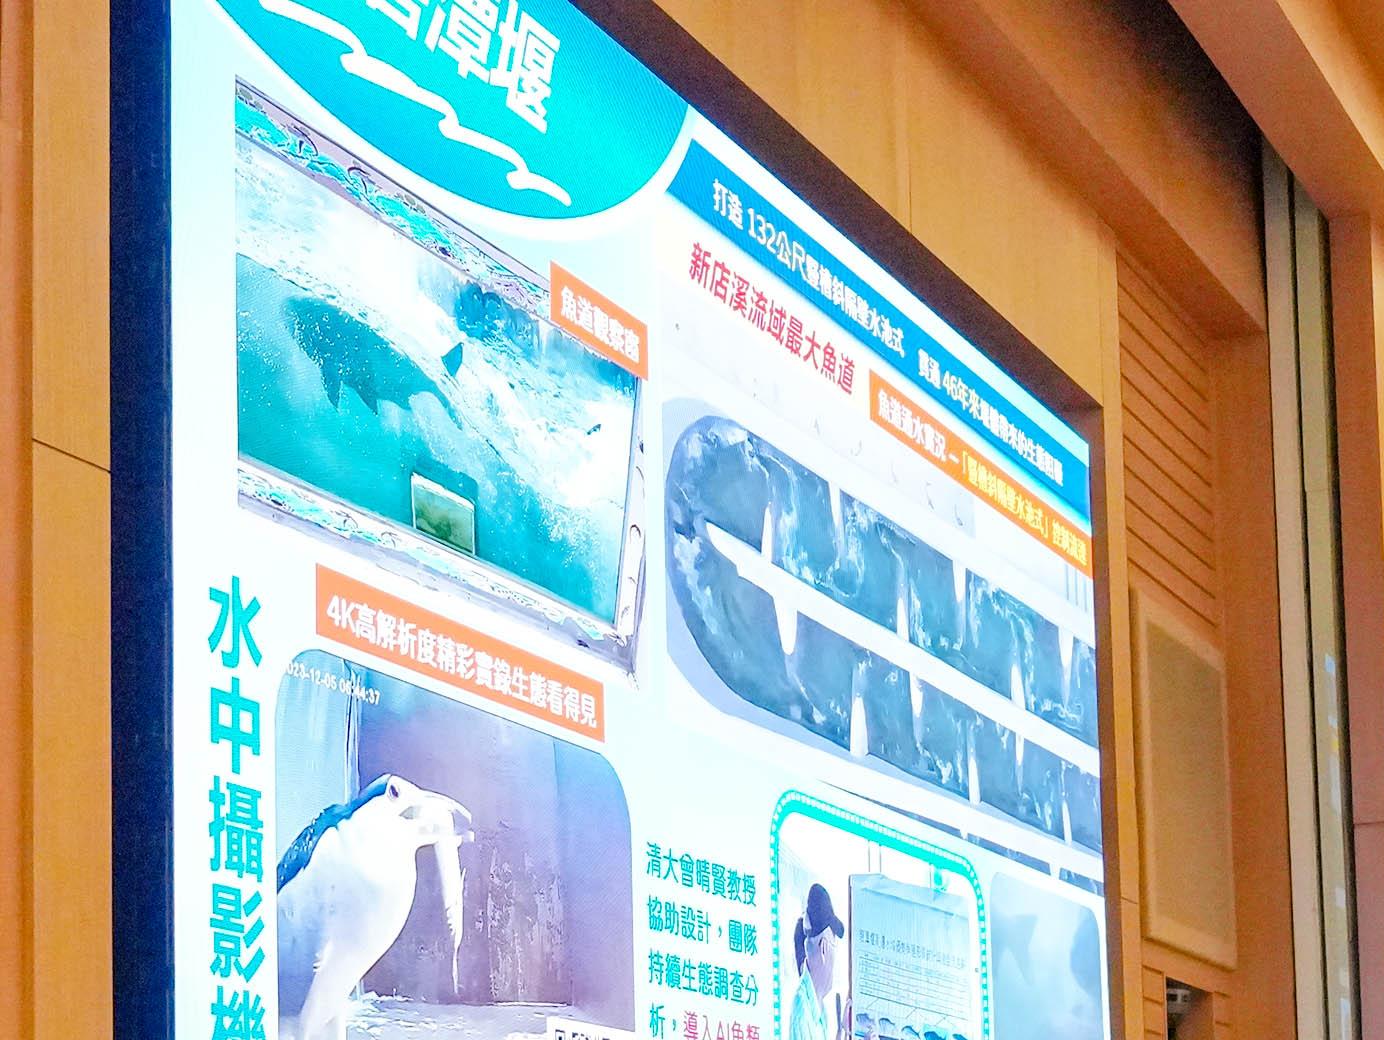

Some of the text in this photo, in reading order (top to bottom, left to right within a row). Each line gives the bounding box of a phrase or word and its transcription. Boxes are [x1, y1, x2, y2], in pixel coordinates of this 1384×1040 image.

[366, 0, 561, 135] 潭堰
[688, 241, 856, 395] 新店溪流域最大魚道
[646, 841, 757, 908] 清大曾晴賢教授
[648, 948, 760, 1006] 持續生態調查分
